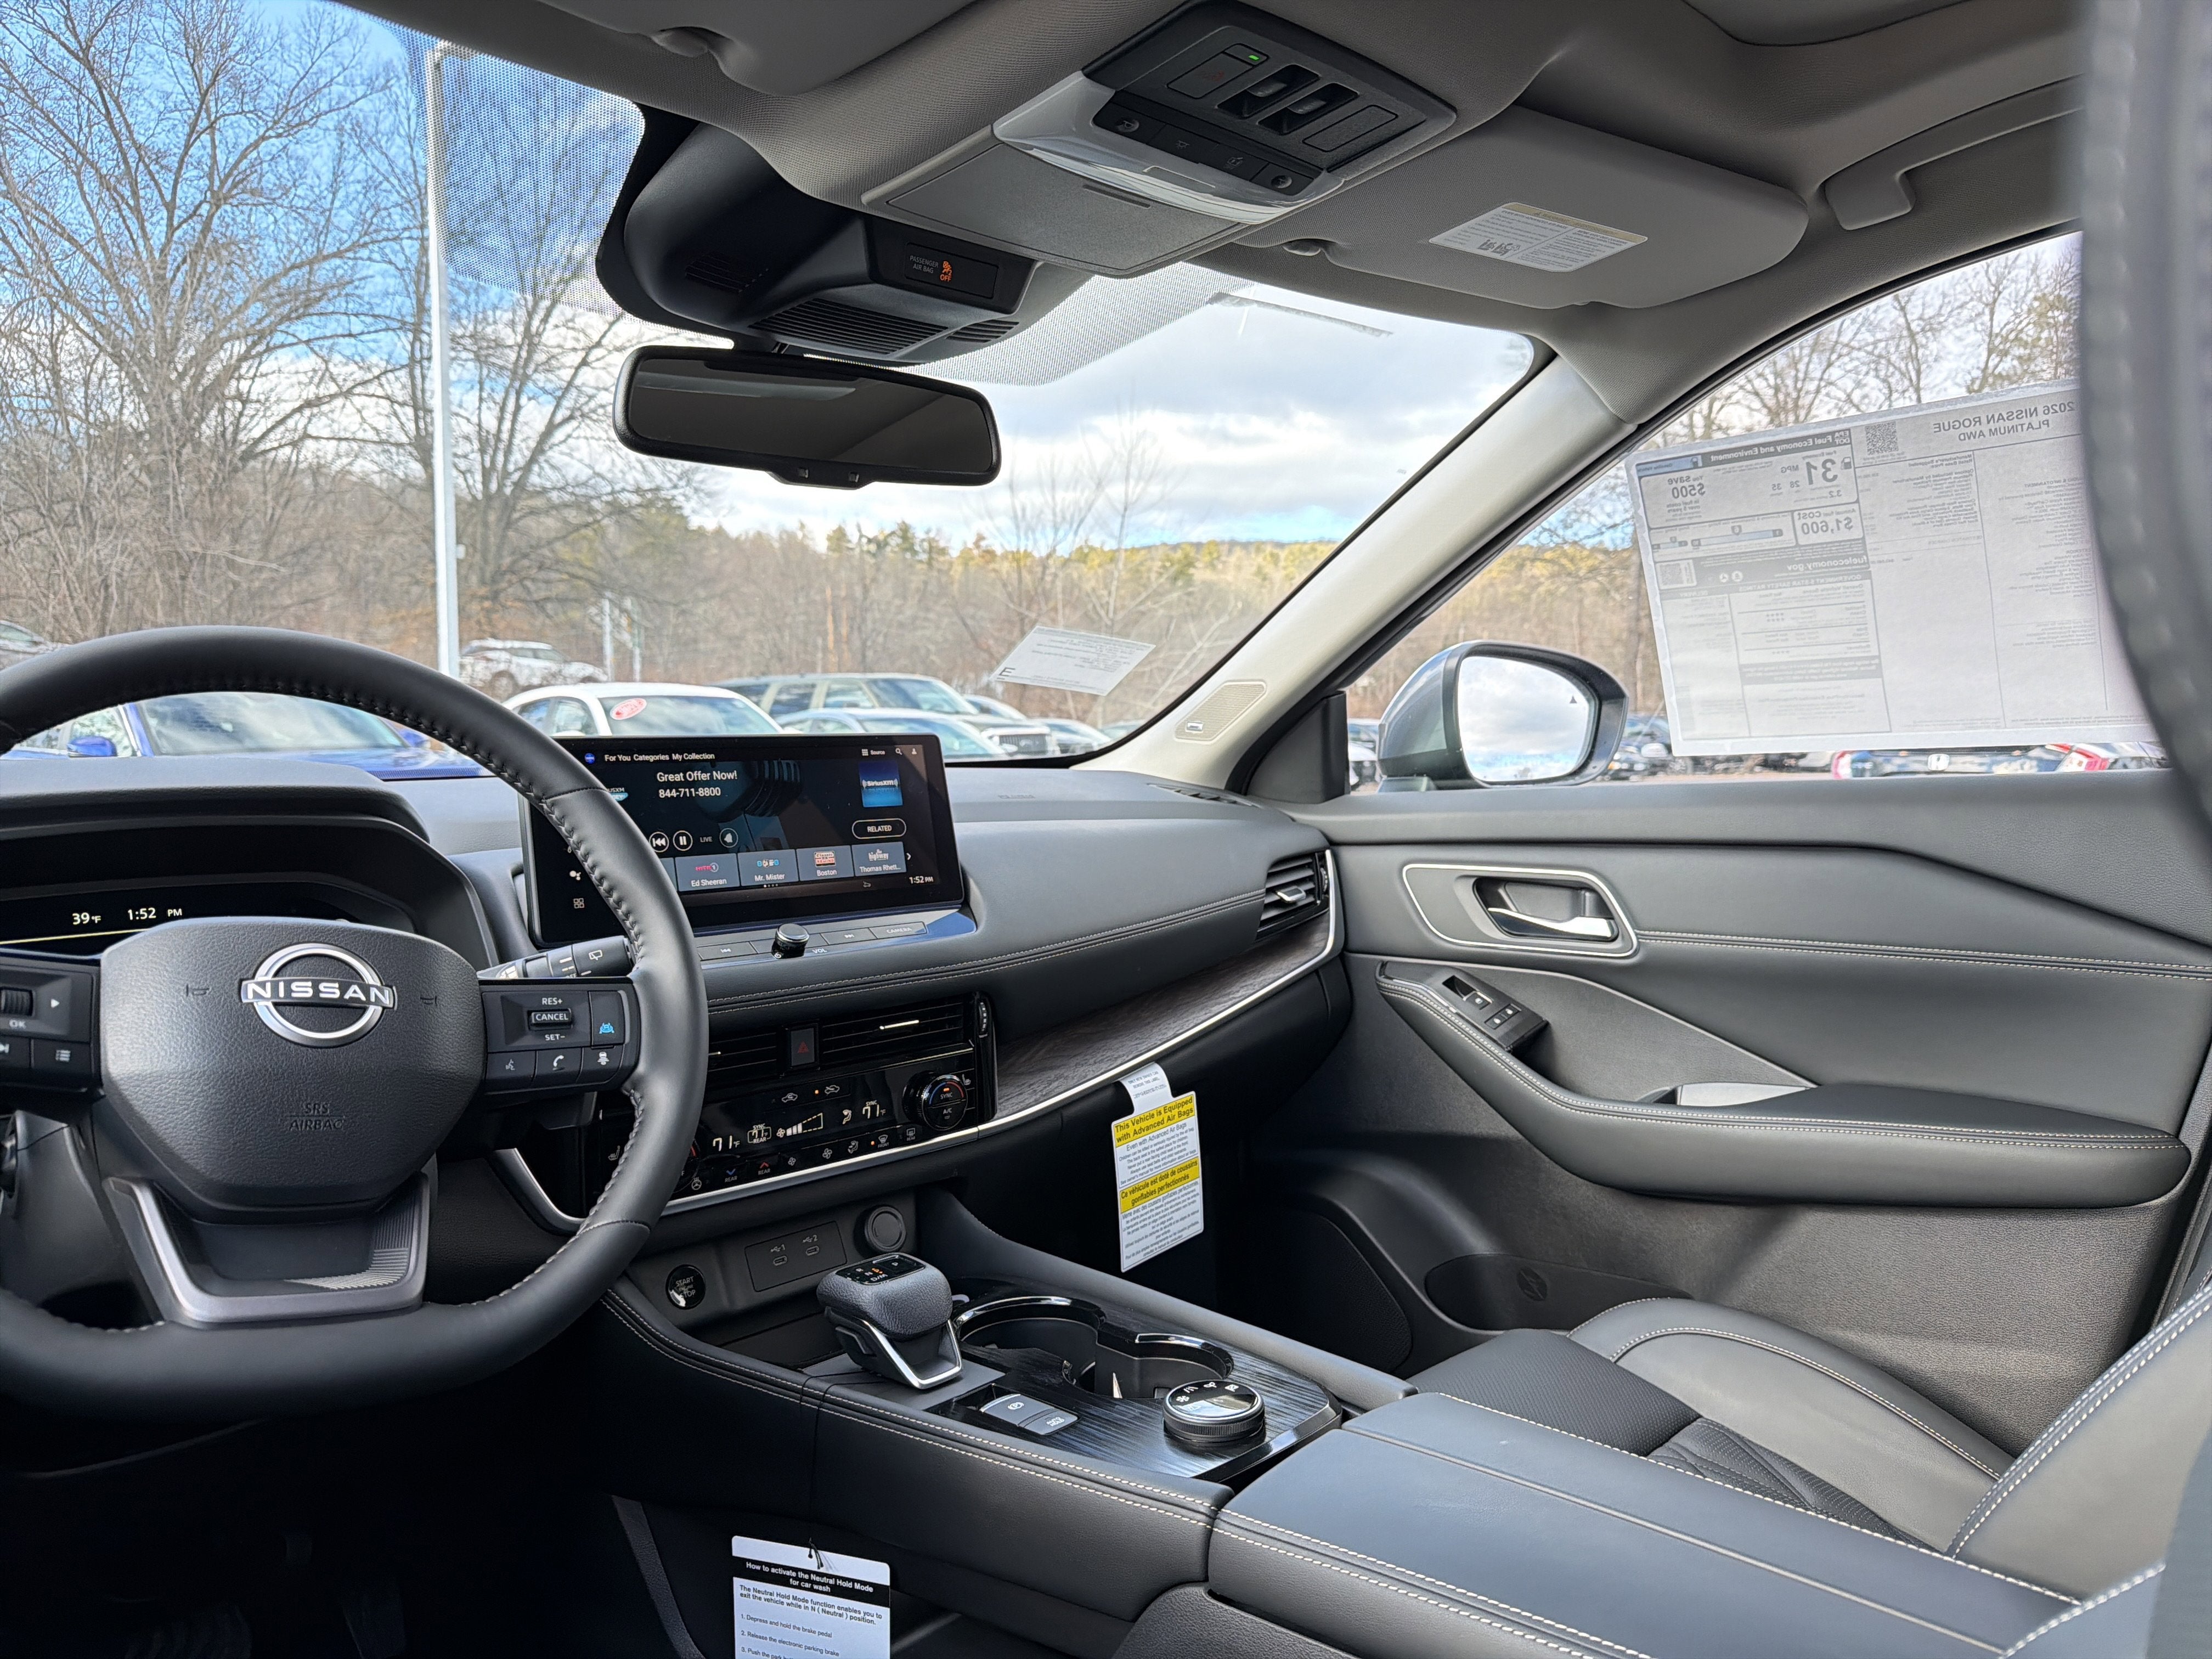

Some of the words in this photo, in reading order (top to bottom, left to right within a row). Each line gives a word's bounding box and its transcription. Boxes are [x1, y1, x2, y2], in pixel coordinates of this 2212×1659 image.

[910, 256, 938, 268] PASSENGER
[634, 753, 669, 761] Categories
[657, 771, 684, 782] Great
[686, 771, 710, 781] Offer
[713, 770, 737, 780] Now!
[659, 787, 721, 798] 844-711-8800
[868, 852, 889, 861] highway
[127, 907, 156, 921] 1:52
[167, 909, 182, 917] PM
[247, 981, 390, 1005] NISSAN
[9, 1018, 26, 1029] OK
[304, 1103, 328, 1114] SRS
[1115, 1124, 1130, 1133] This
[1131, 1114, 1154, 1126] Vehicle
[1164, 1096, 1192, 1113] Equipped
[289, 1119, 343, 1131] AIRBAG
[1116, 1133, 1131, 1143] with
[1133, 1119, 1164, 1136] Advanced
[1178, 1108, 1193, 1118] Bags
[1148, 1129, 1169, 1142] Advanced
[1129, 1182, 1149, 1195] véhicule
[1159, 1171, 1169, 1183] doté
[1177, 1160, 1198, 1173] coussins
[1131, 1189, 1156, 1206] gonflables
[1158, 1173, 1189, 1194] perfectionnés
[676, 1276, 693, 1287] START
[746, 1561, 761, 1571] How
[771, 1567, 796, 1577] activate
[798, 1571, 809, 1579] the
[811, 1573, 834, 1584] Neutral
[837, 1579, 853, 1588] Hold
[854, 1583, 873, 1592] Mode
[813, 1583, 831, 1592] wash
[753, 1588, 775, 1596] Neutral
[792, 1595, 809, 1604] Mode
[810, 1599, 835, 1609] function
[837, 1605, 861, 1615] enables
[764, 1597, 784, 1606] vehicle
[821, 1609, 844, 1618] Neutral
[850, 1614, 876, 1625] position.
[747, 1615, 768, 1623] Depress
[747, 1631, 768, 1641] Release
[778, 1639, 803, 1649] electronic
[804, 1645, 823, 1654] parking
[825, 1648, 839, 1657] brake
